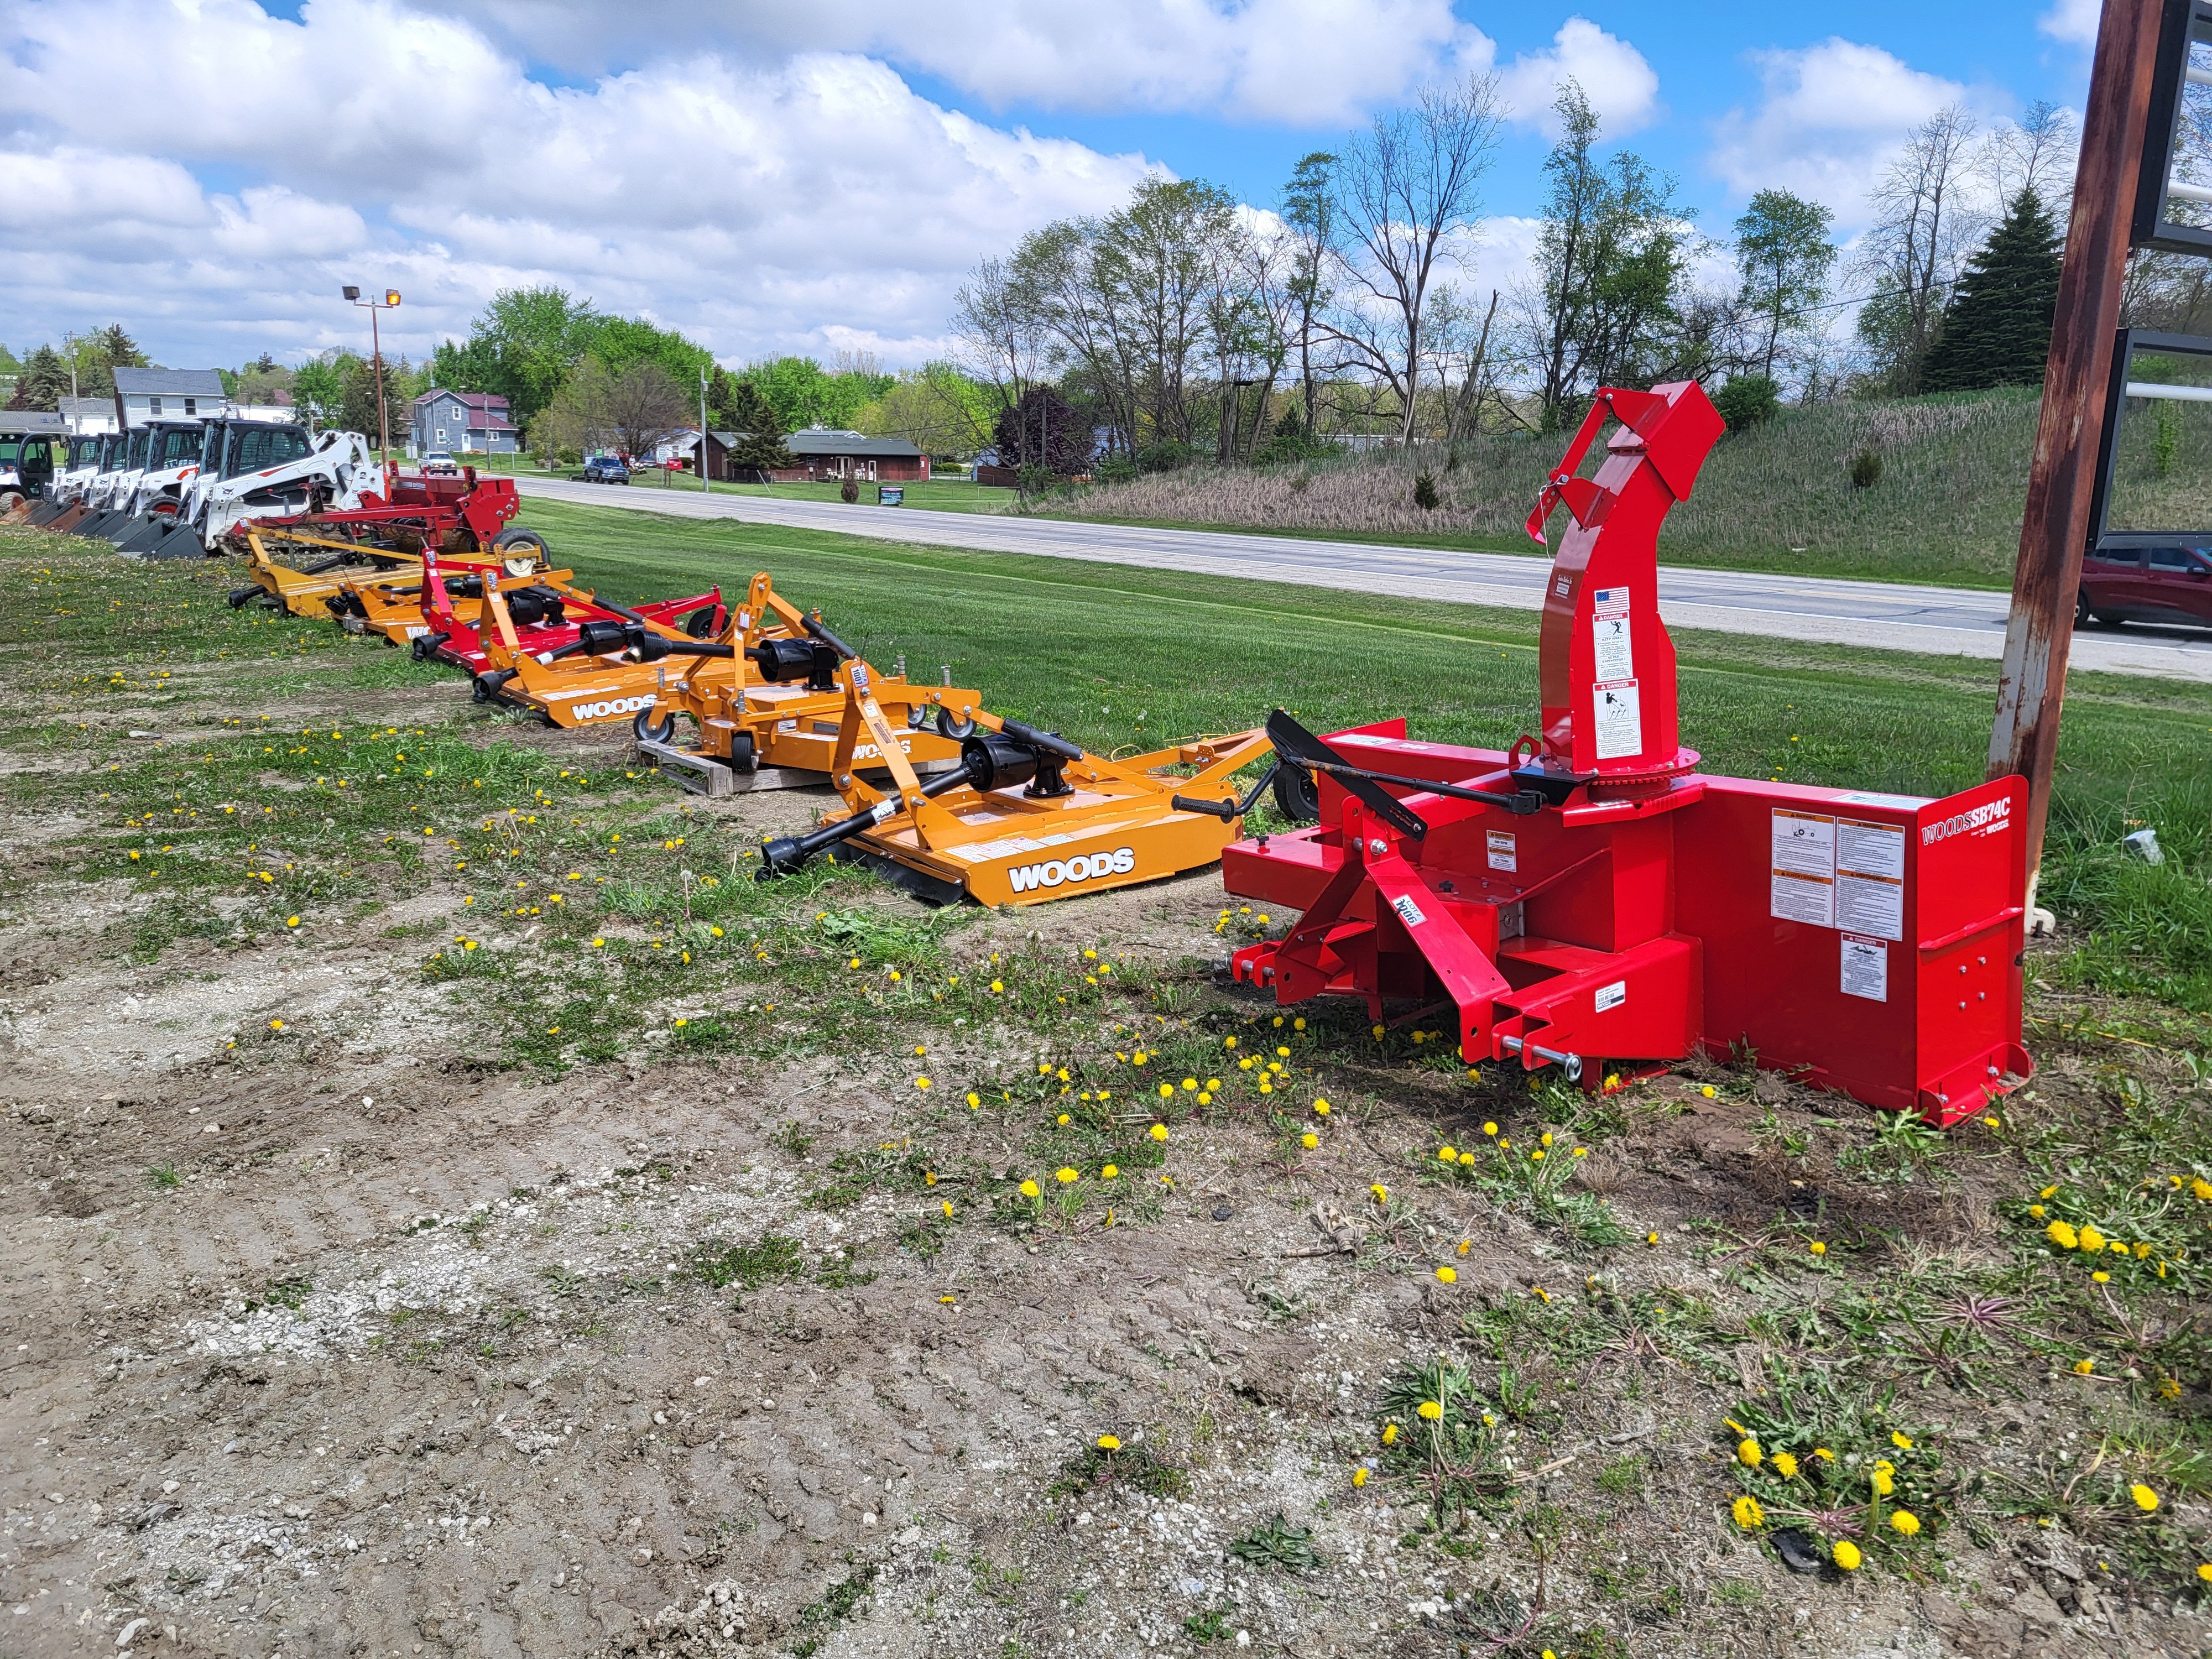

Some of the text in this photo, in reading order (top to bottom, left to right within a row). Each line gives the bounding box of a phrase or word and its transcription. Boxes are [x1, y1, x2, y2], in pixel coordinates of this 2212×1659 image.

[852, 669, 863, 685] 1007
[571, 693, 658, 721] WOODS
[852, 739, 911, 760] WOS
[1008, 847, 1135, 894] WOODS
[1406, 900, 1419, 913] LOT
[1855, 937, 1877, 946] DANGER
